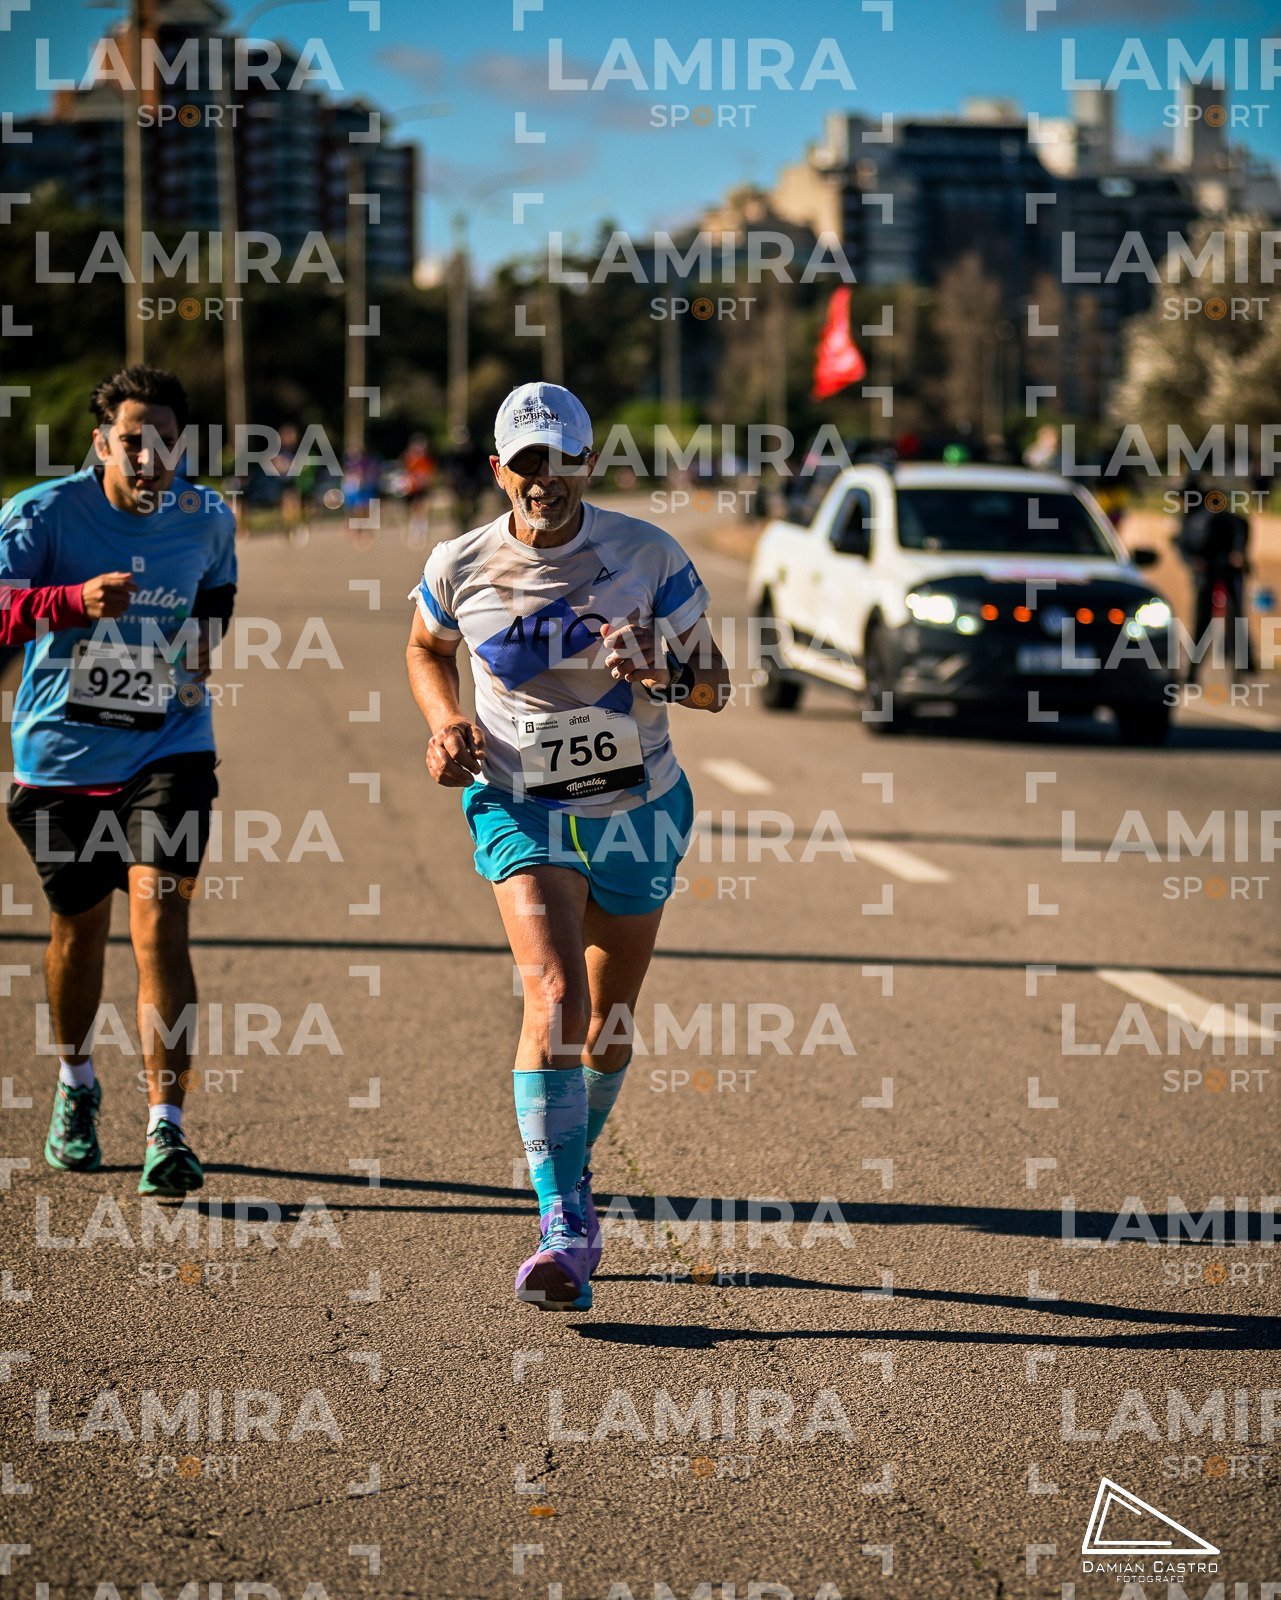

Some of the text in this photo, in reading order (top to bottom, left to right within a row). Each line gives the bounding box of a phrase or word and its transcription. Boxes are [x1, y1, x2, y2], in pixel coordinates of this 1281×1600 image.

[88, 666, 152, 702] 922
[541, 731, 618, 772] 756
[566, 777, 607, 793] Maratón
